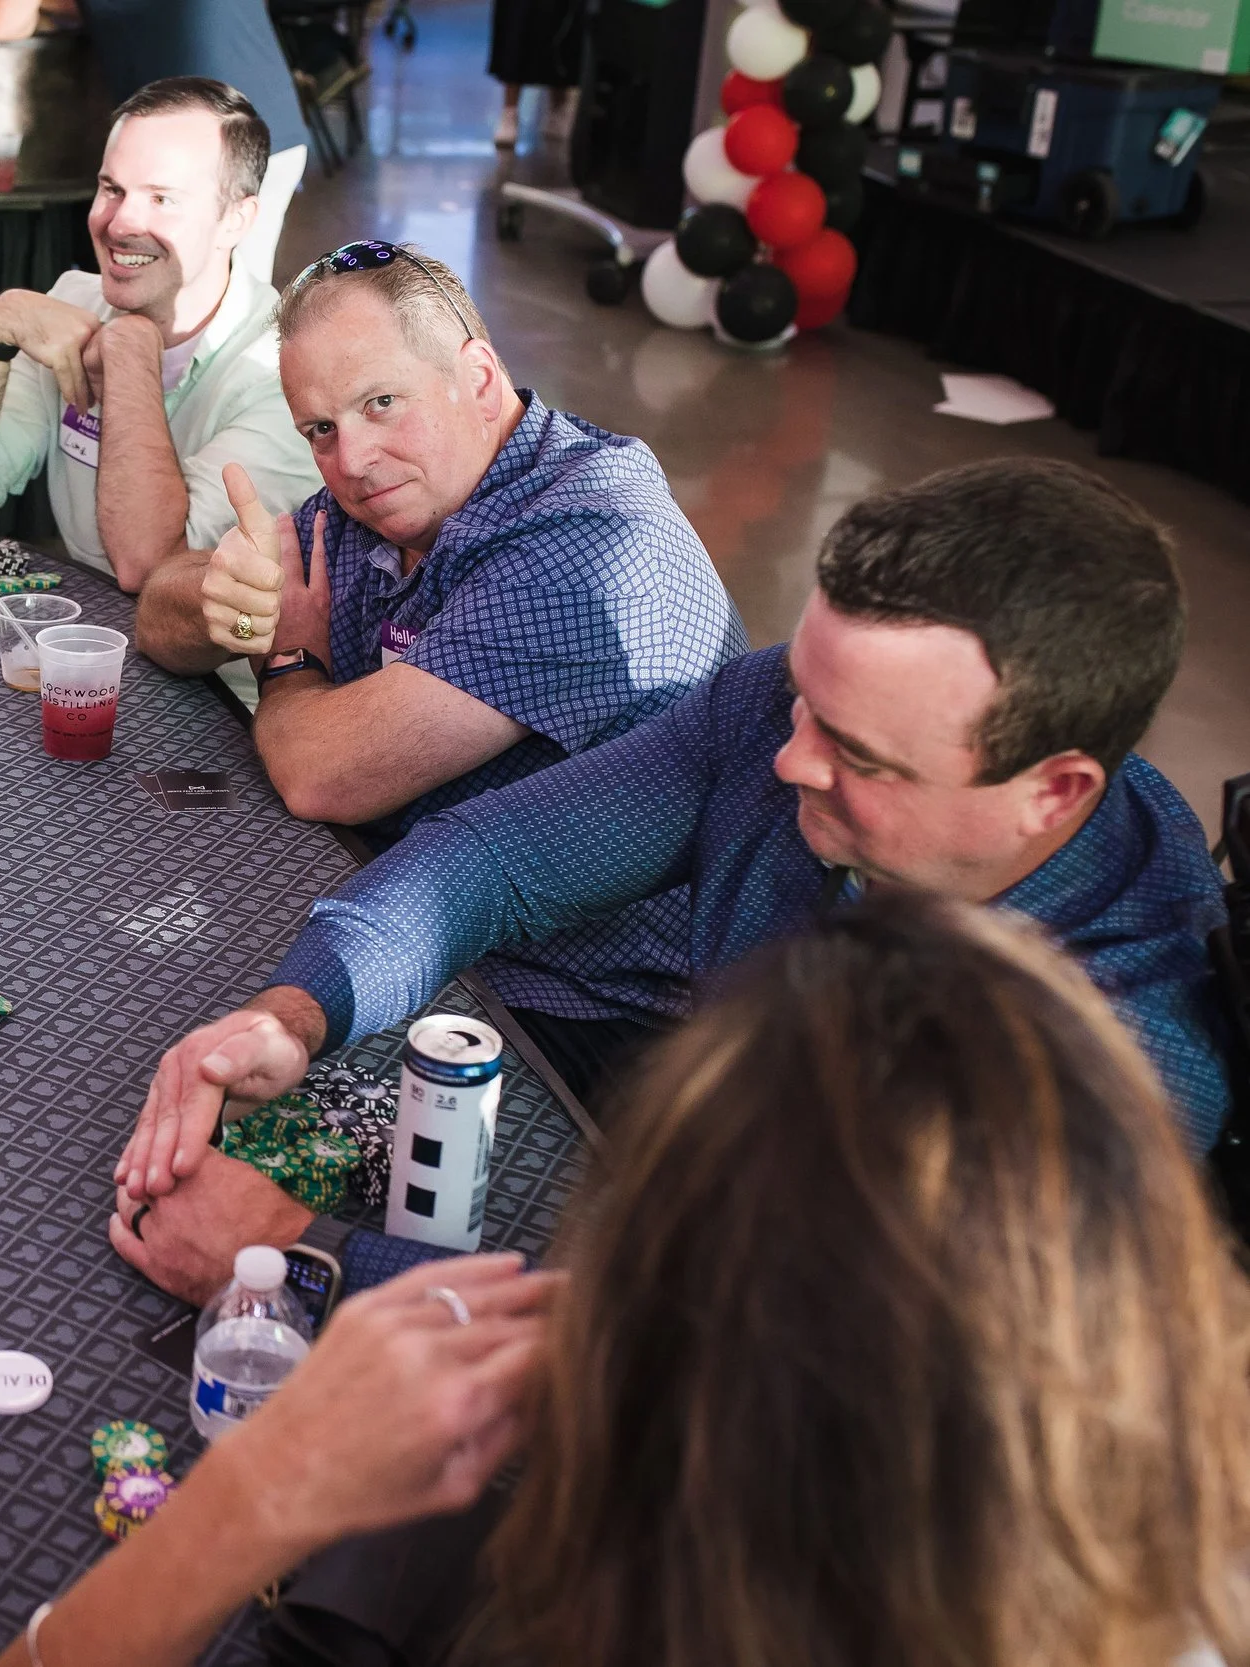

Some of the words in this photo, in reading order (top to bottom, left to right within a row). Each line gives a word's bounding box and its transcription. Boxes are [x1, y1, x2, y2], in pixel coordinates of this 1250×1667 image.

[42, 681, 115, 697] LOCKWOOD
[42, 693, 114, 709] DISTILLING
[66, 712, 87, 721] CO
